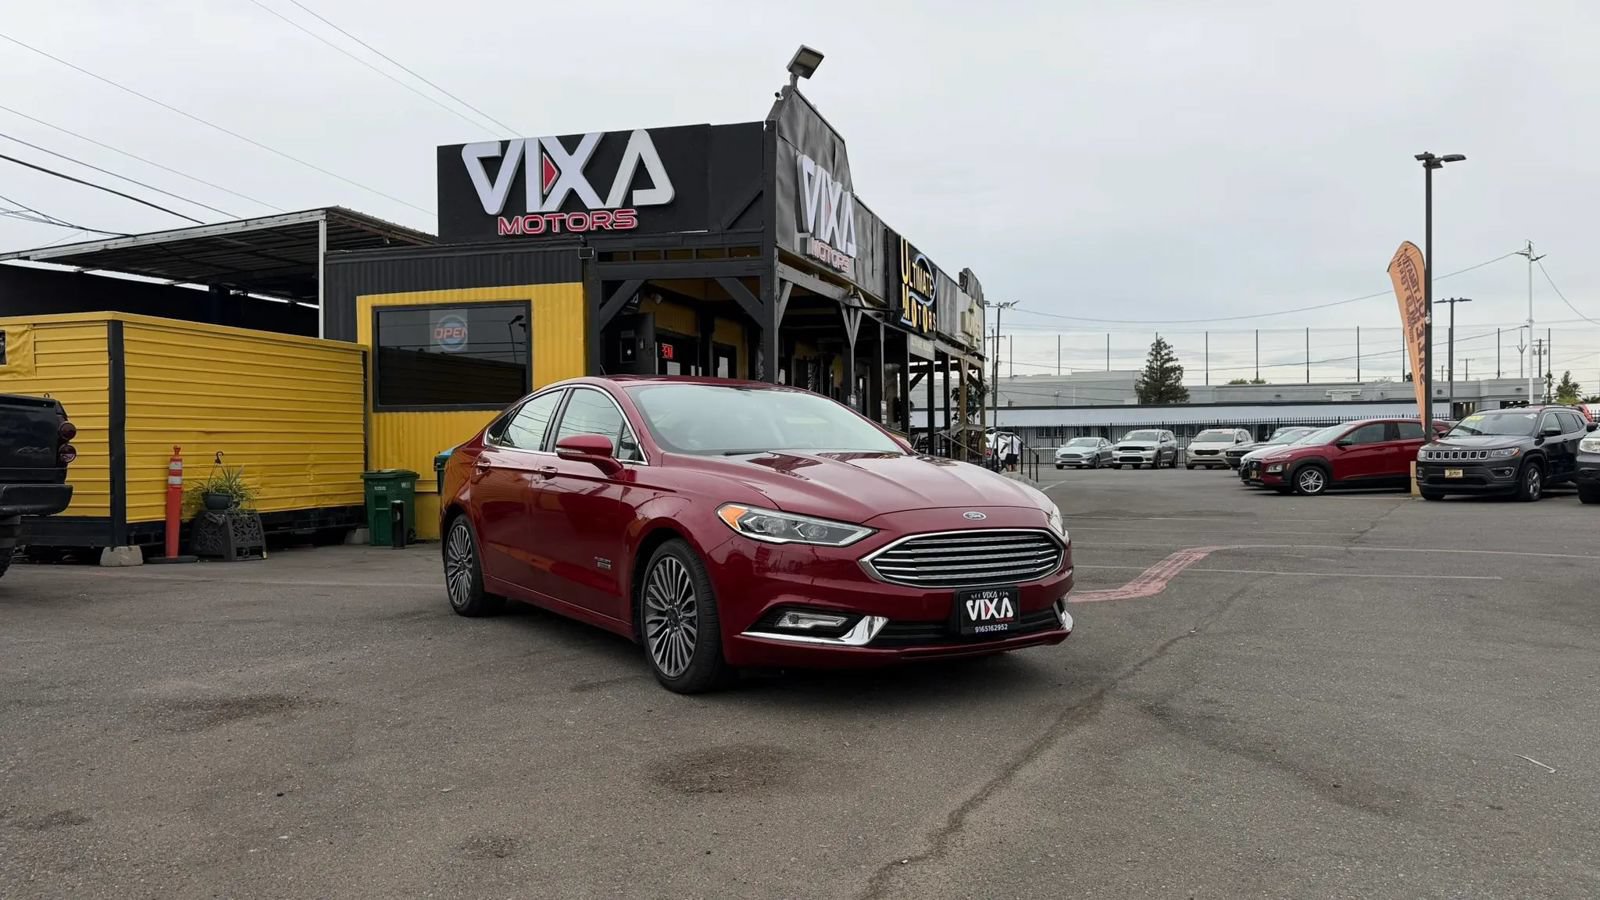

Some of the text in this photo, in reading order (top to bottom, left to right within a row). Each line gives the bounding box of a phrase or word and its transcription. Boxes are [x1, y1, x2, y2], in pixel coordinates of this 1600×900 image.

[461, 129, 675, 215] VIXA
[498, 209, 638, 235] MOTORS
[798, 155, 856, 258] VIXA
[811, 240, 850, 273] MOTORS
[902, 283, 936, 333] MOTORS
[966, 597, 1014, 621] VIXA
